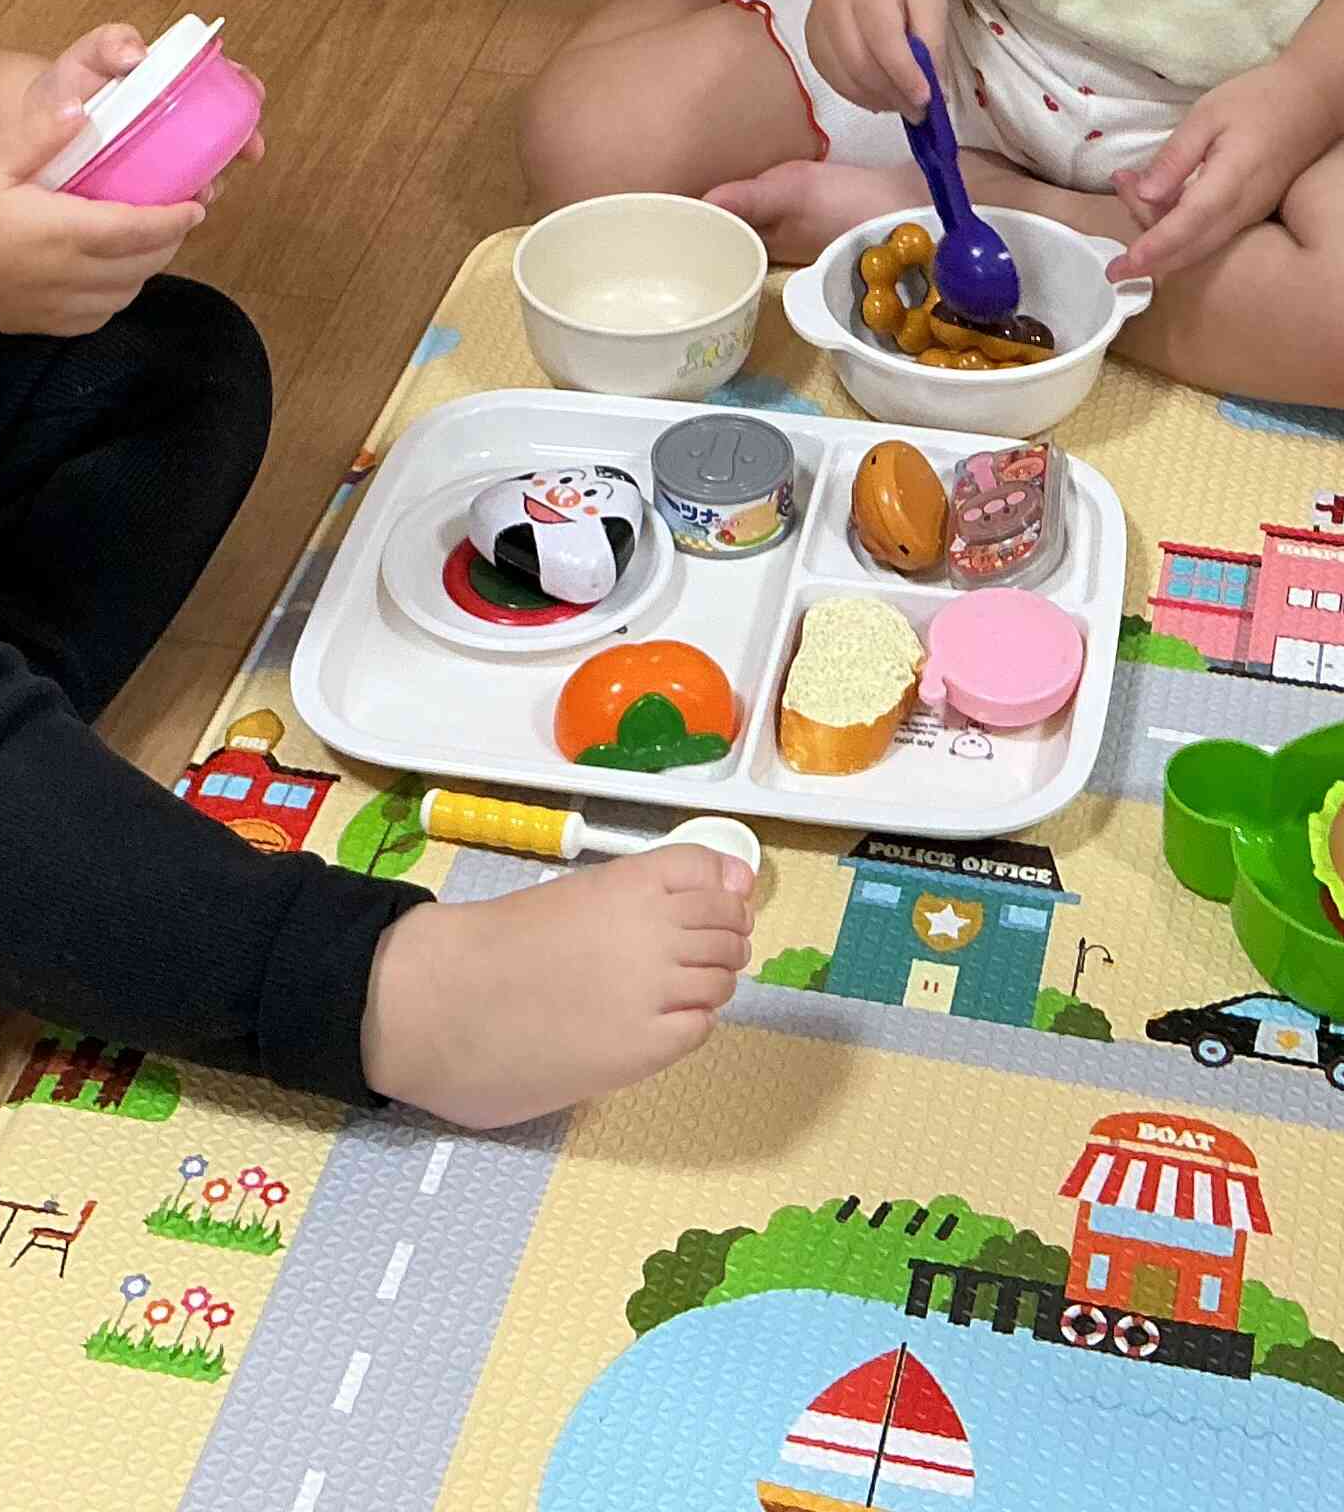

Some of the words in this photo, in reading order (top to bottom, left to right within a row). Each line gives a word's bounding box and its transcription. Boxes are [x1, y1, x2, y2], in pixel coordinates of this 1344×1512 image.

[867, 840, 956, 868] POLICE
[961, 856, 1053, 885] OFFICE
[1136, 1121, 1216, 1152] BOAT
